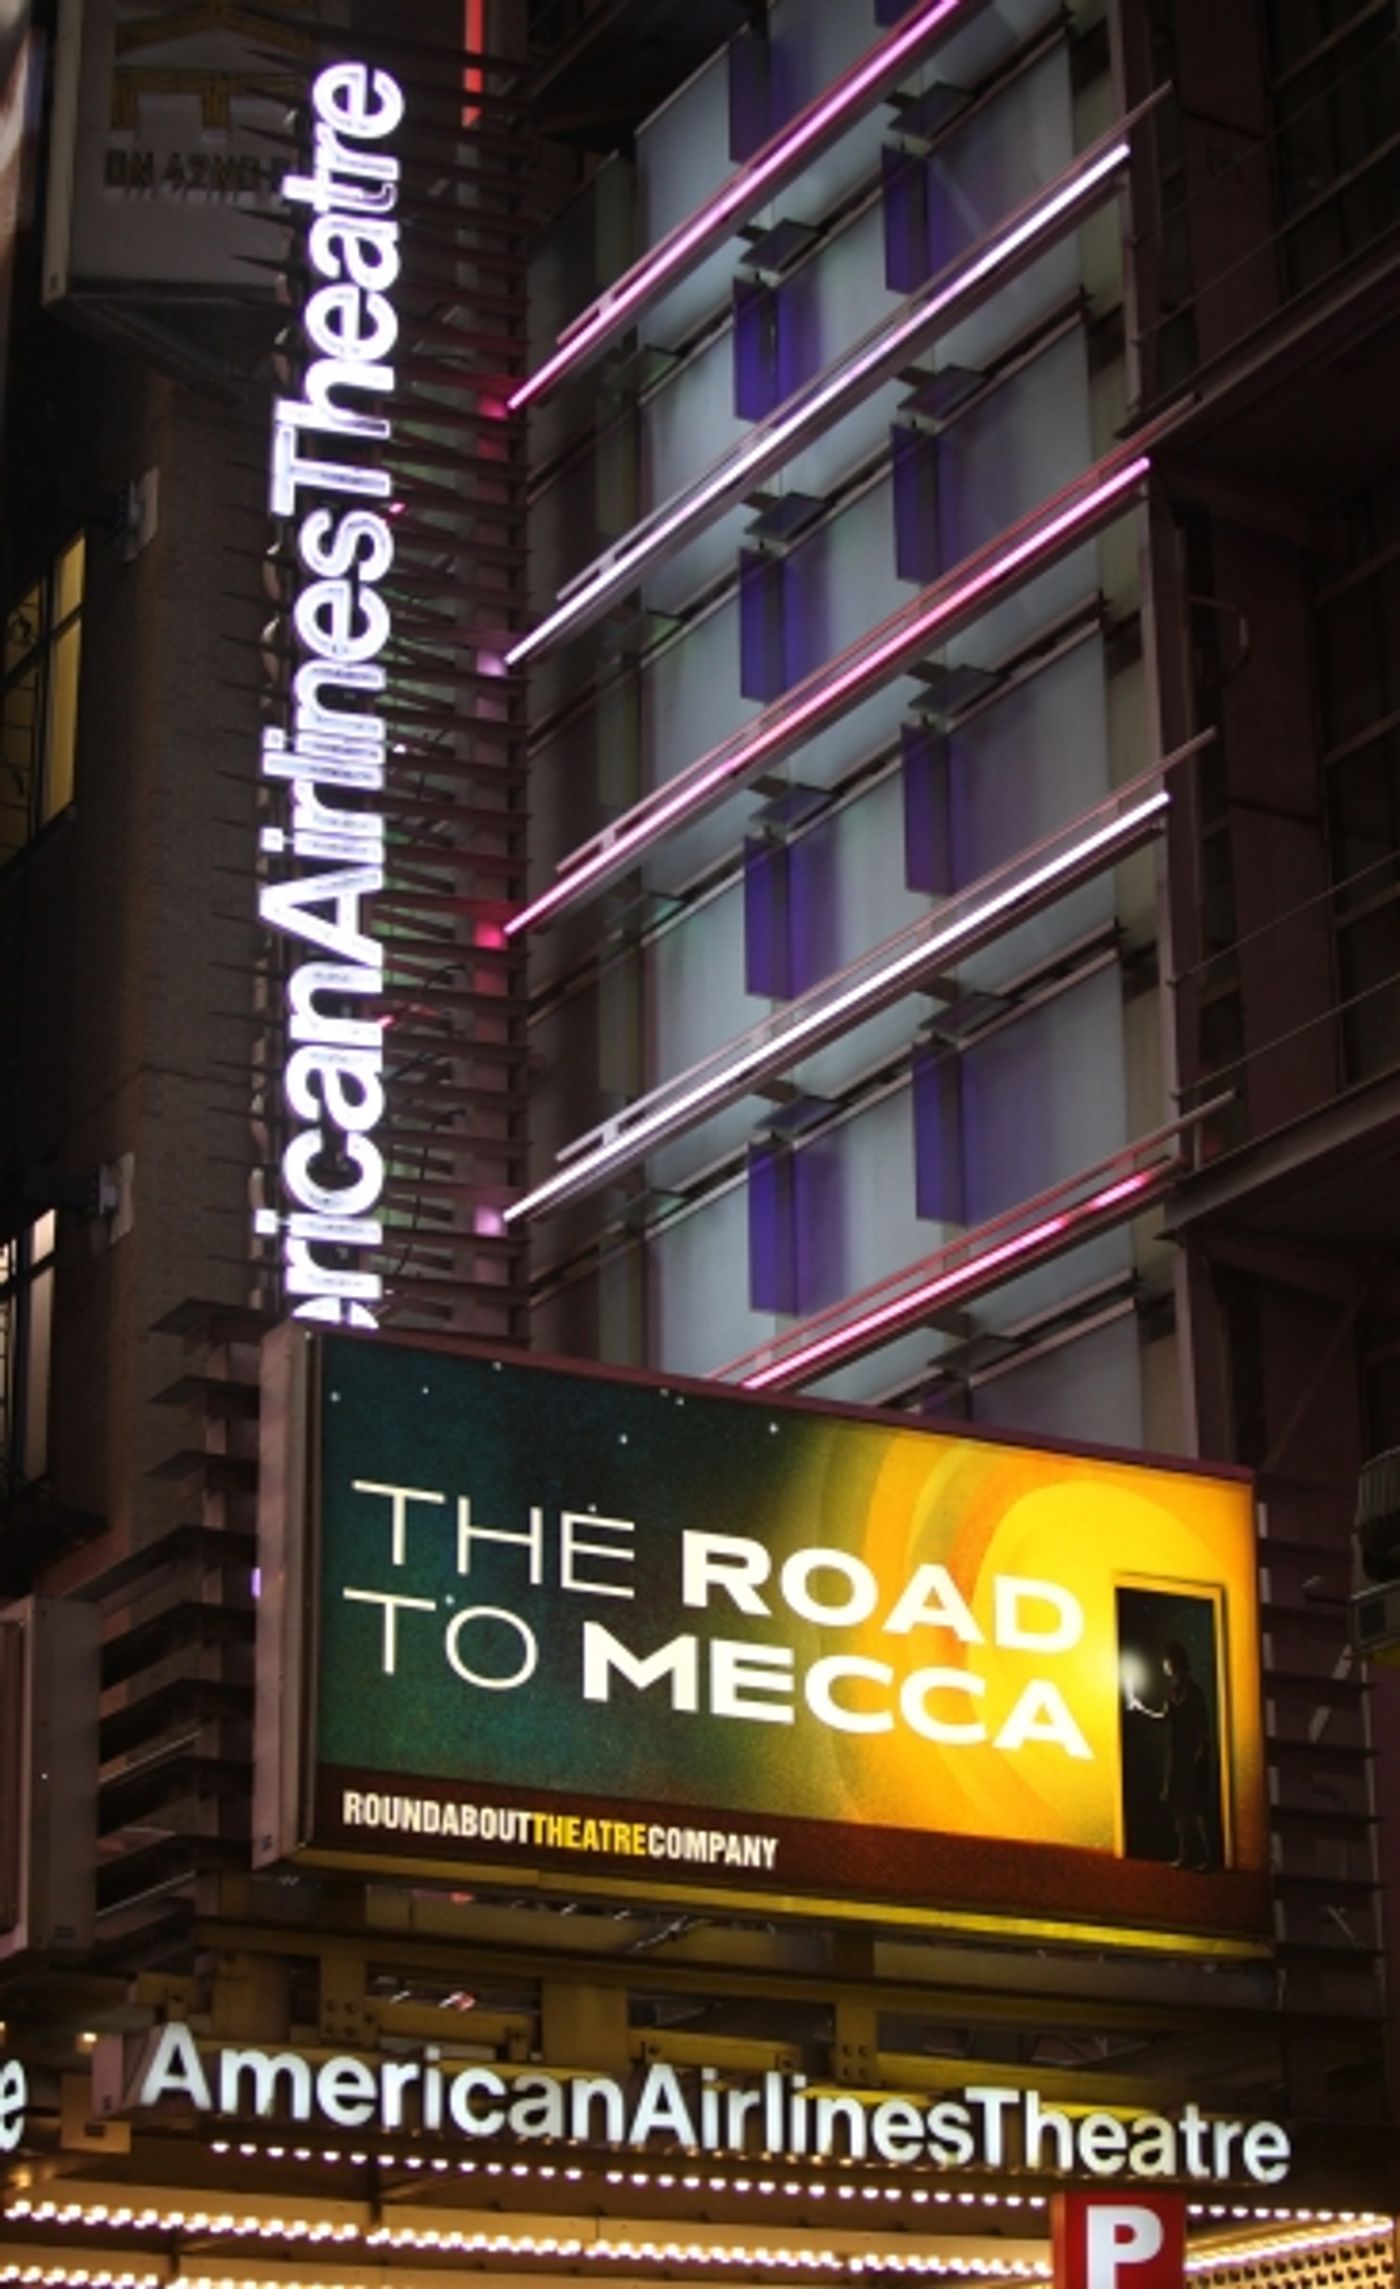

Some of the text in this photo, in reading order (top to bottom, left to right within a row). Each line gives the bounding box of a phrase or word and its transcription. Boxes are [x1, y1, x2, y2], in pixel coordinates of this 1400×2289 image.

[351, 1479, 1085, 1655] THE ROAD
[342, 1588, 1094, 1761] TO MECCA
[140, 2021, 1292, 2184] AmericanAirlinesTheatre
[1087, 2205, 1164, 2289] P
